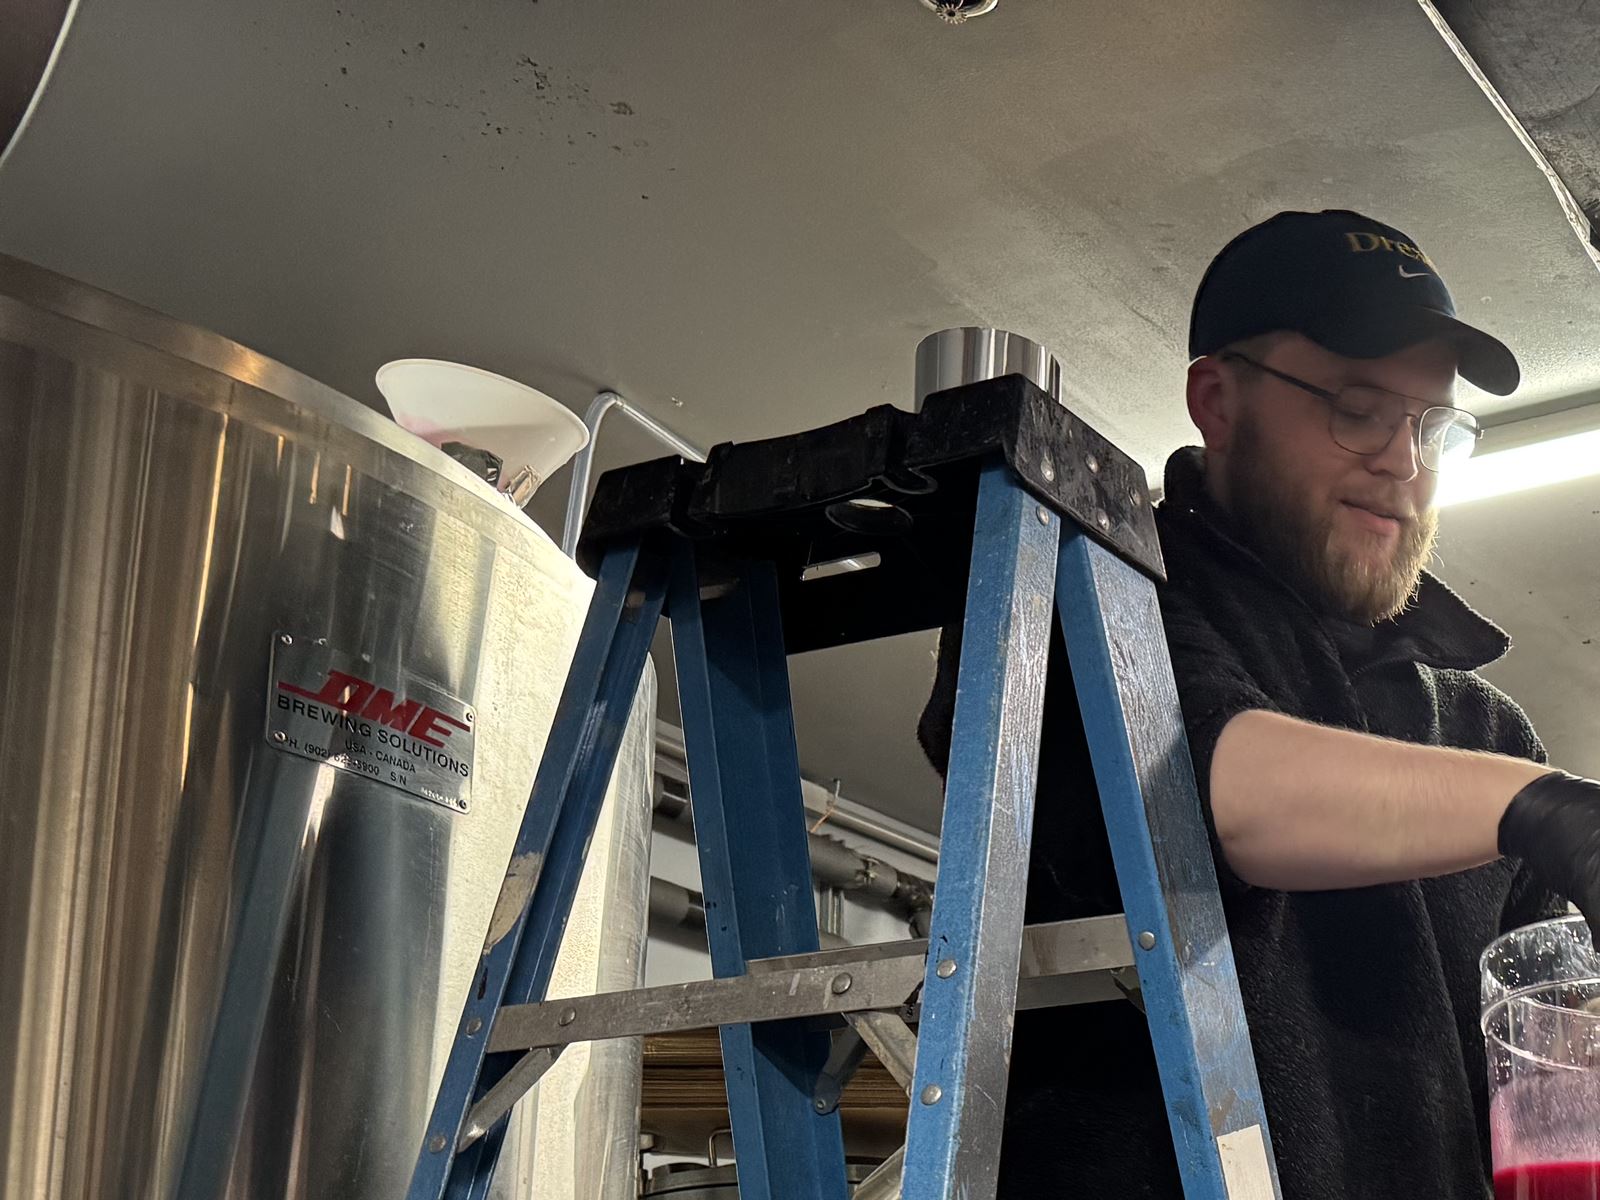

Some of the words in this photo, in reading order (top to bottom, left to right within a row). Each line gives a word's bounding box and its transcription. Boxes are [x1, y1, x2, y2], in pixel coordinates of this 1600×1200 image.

[277, 669, 470, 749] DME
[277, 693, 371, 737] BREWING
[377, 729, 469, 778] SOLUTIONS
[345, 740, 367, 756] USA
[375, 750, 417, 774] CANADA
